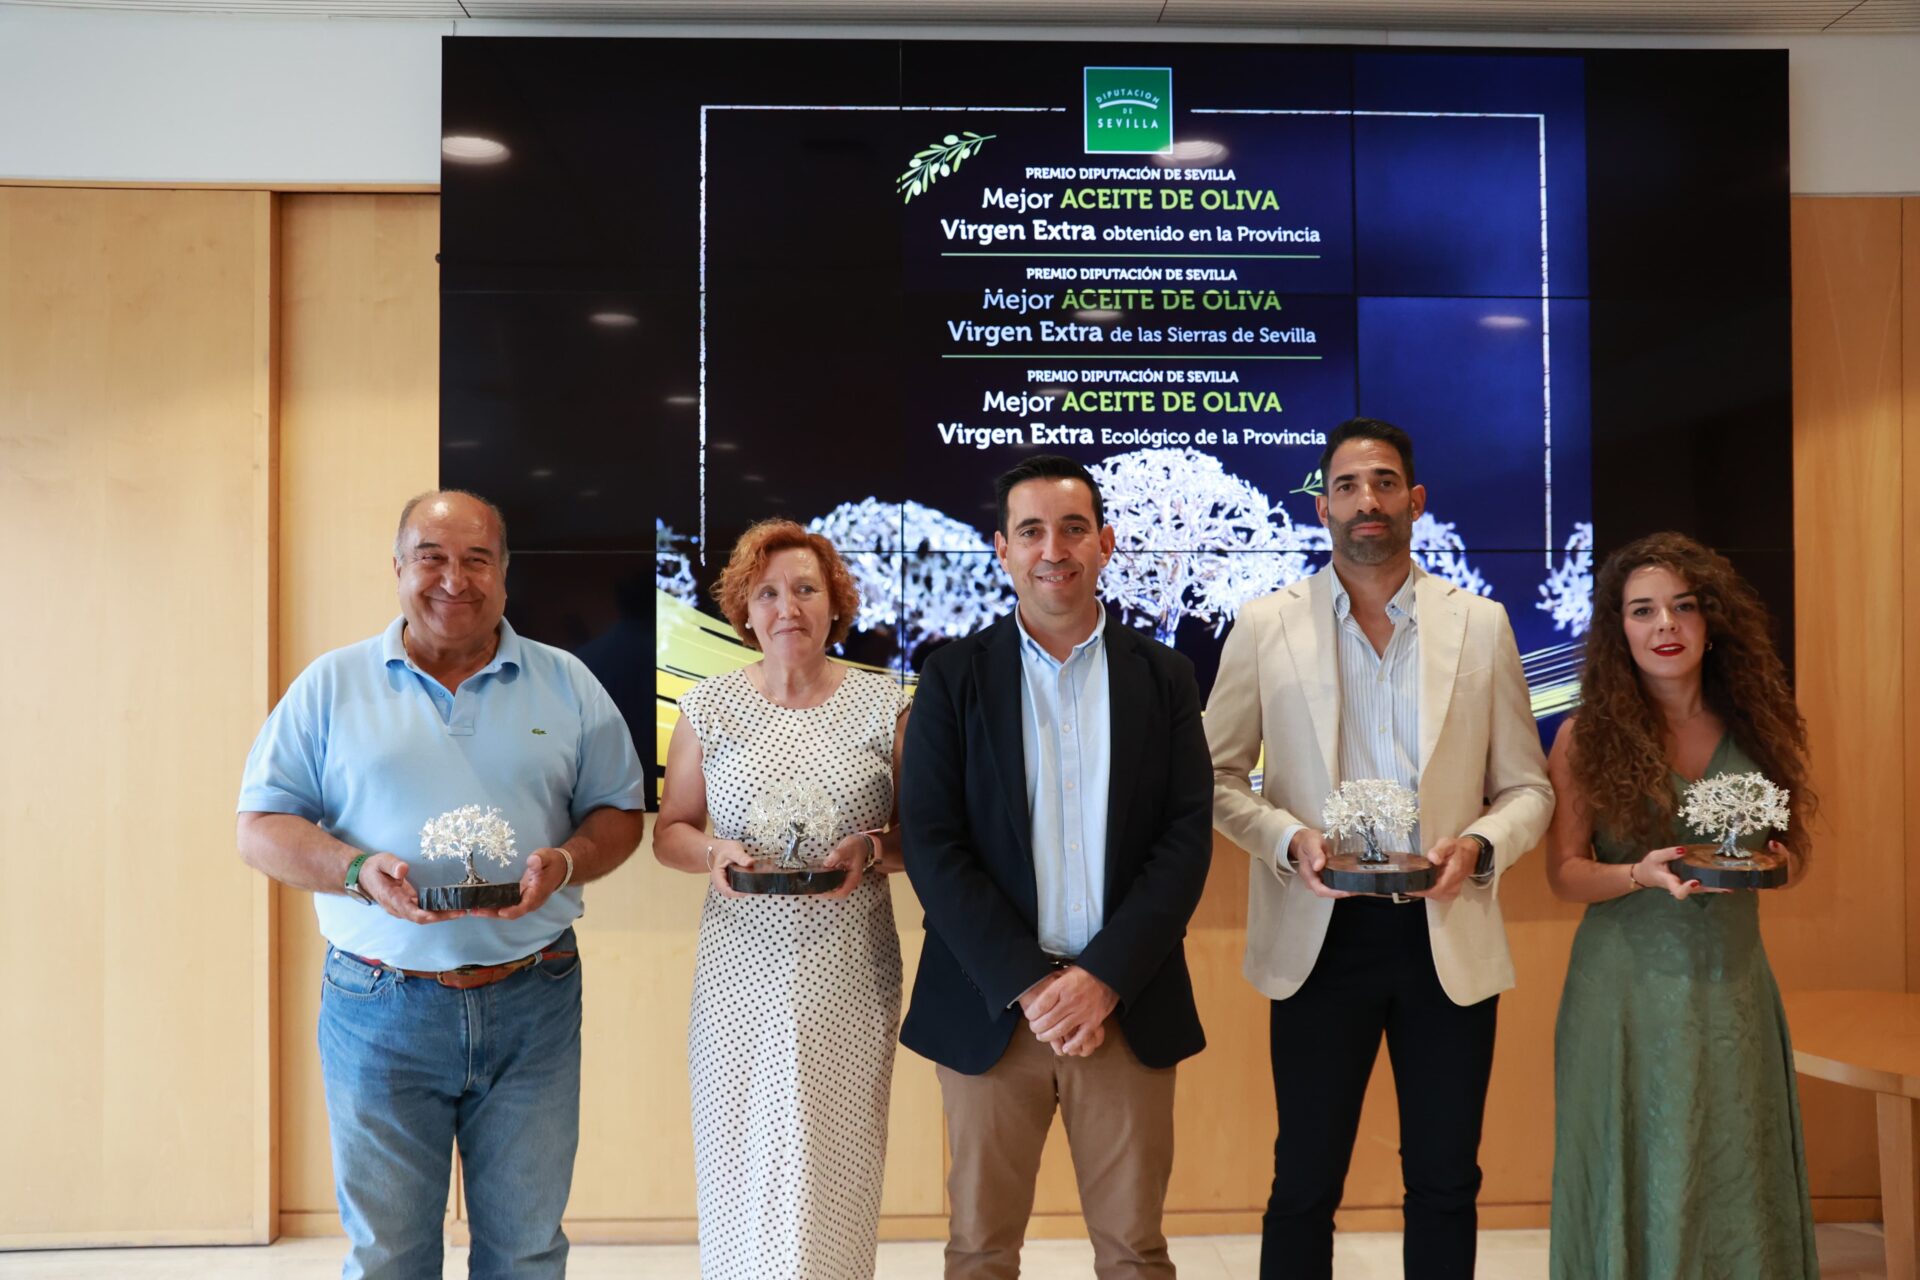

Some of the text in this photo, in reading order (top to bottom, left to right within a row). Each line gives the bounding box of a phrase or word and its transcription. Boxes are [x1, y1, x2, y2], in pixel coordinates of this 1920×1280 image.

[1097, 118, 1159, 129] SEVILLA
[1122, 107, 1133, 115] DE
[1025, 166, 1237, 181] PREMIO DIPUTACIÓN DE SEVILLA
[981, 187, 1280, 214] Mejor ACEITE DE OLIVA
[940, 218, 1322, 246] Virgen Extra obtenido en la Provincia
[1025, 265, 1238, 281] PREMIO DIPUTACIÓN DE SEVILLA
[982, 288, 1282, 315] Mejor ACEITE DE OLIVA
[947, 320, 1317, 348] Virgen Extra de las Sierras de Sevilla
[1026, 367, 1240, 383] PREMIO DIPUTACIÓN DE SEVILLA
[982, 390, 1283, 418] Mejor ACEITE DE OLIVA
[937, 422, 1328, 450] Virgen Extra Ecológico de la Provincia
